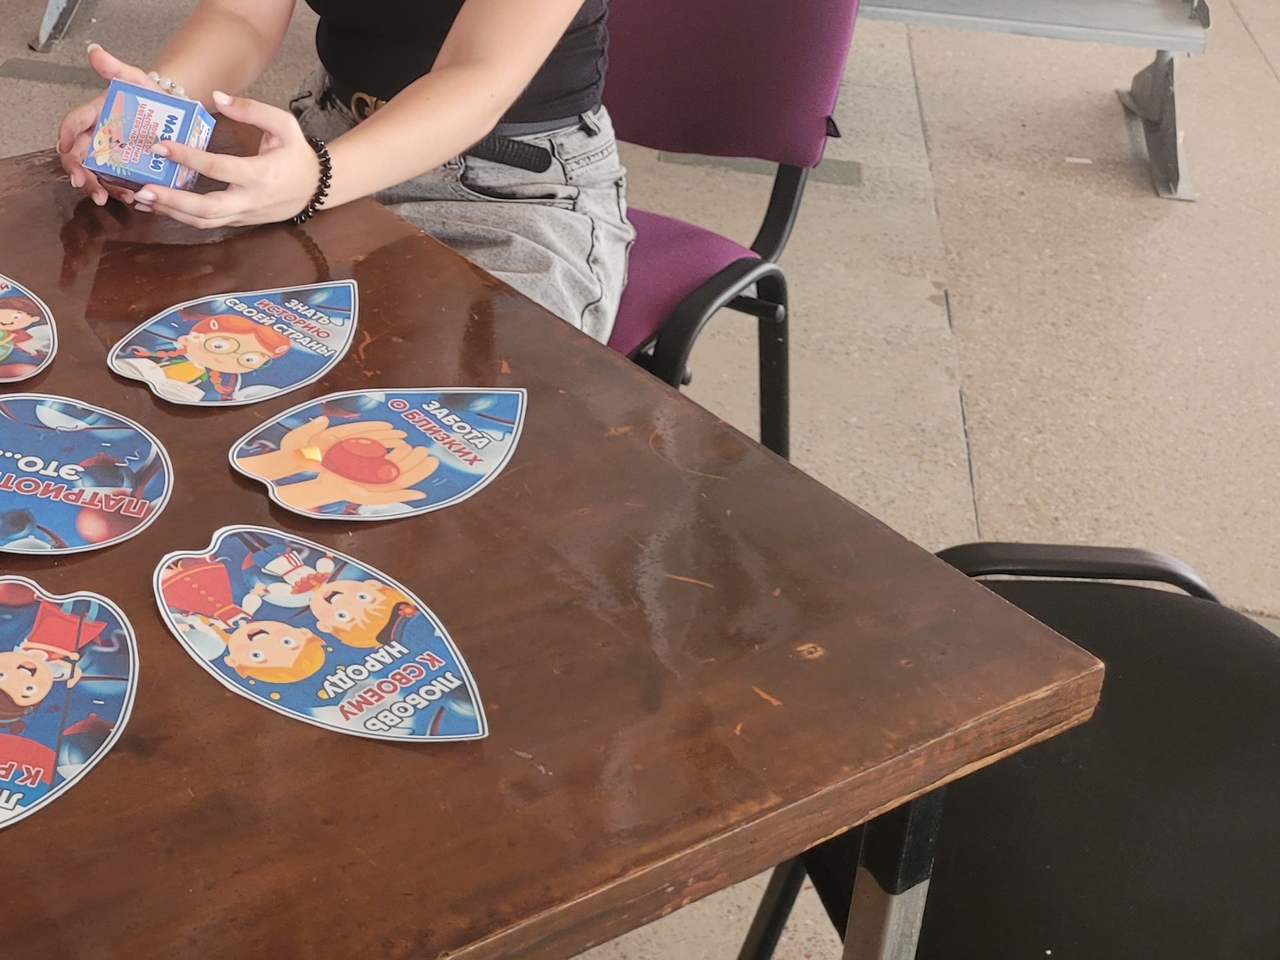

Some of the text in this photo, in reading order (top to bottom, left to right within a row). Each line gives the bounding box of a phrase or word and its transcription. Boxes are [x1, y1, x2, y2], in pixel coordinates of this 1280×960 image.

[131, 109, 154, 163] РАСПОЛОЖЕНИЯ
[133, 103, 147, 131] ЦВЕТОВ
[143, 122, 160, 155] ПОРЯДОК
[149, 114, 179, 173] НАЗВИ
[224, 297, 338, 358] СВОЕЙ СТРАНЫ
[254, 298, 332, 340] ИСТОРИЮ
[284, 298, 331, 326] ЗНАТЬ
[387, 398, 485, 467] О БЛИЗКИХ
[422, 399, 493, 451] ЗАБОТА
[321, 640, 410, 700] НАРОДУ
[338, 651, 446, 722] К СВОЕМУ
[363, 671, 463, 733] ЛЮБОВЬ
[18, 764, 43, 788] К
